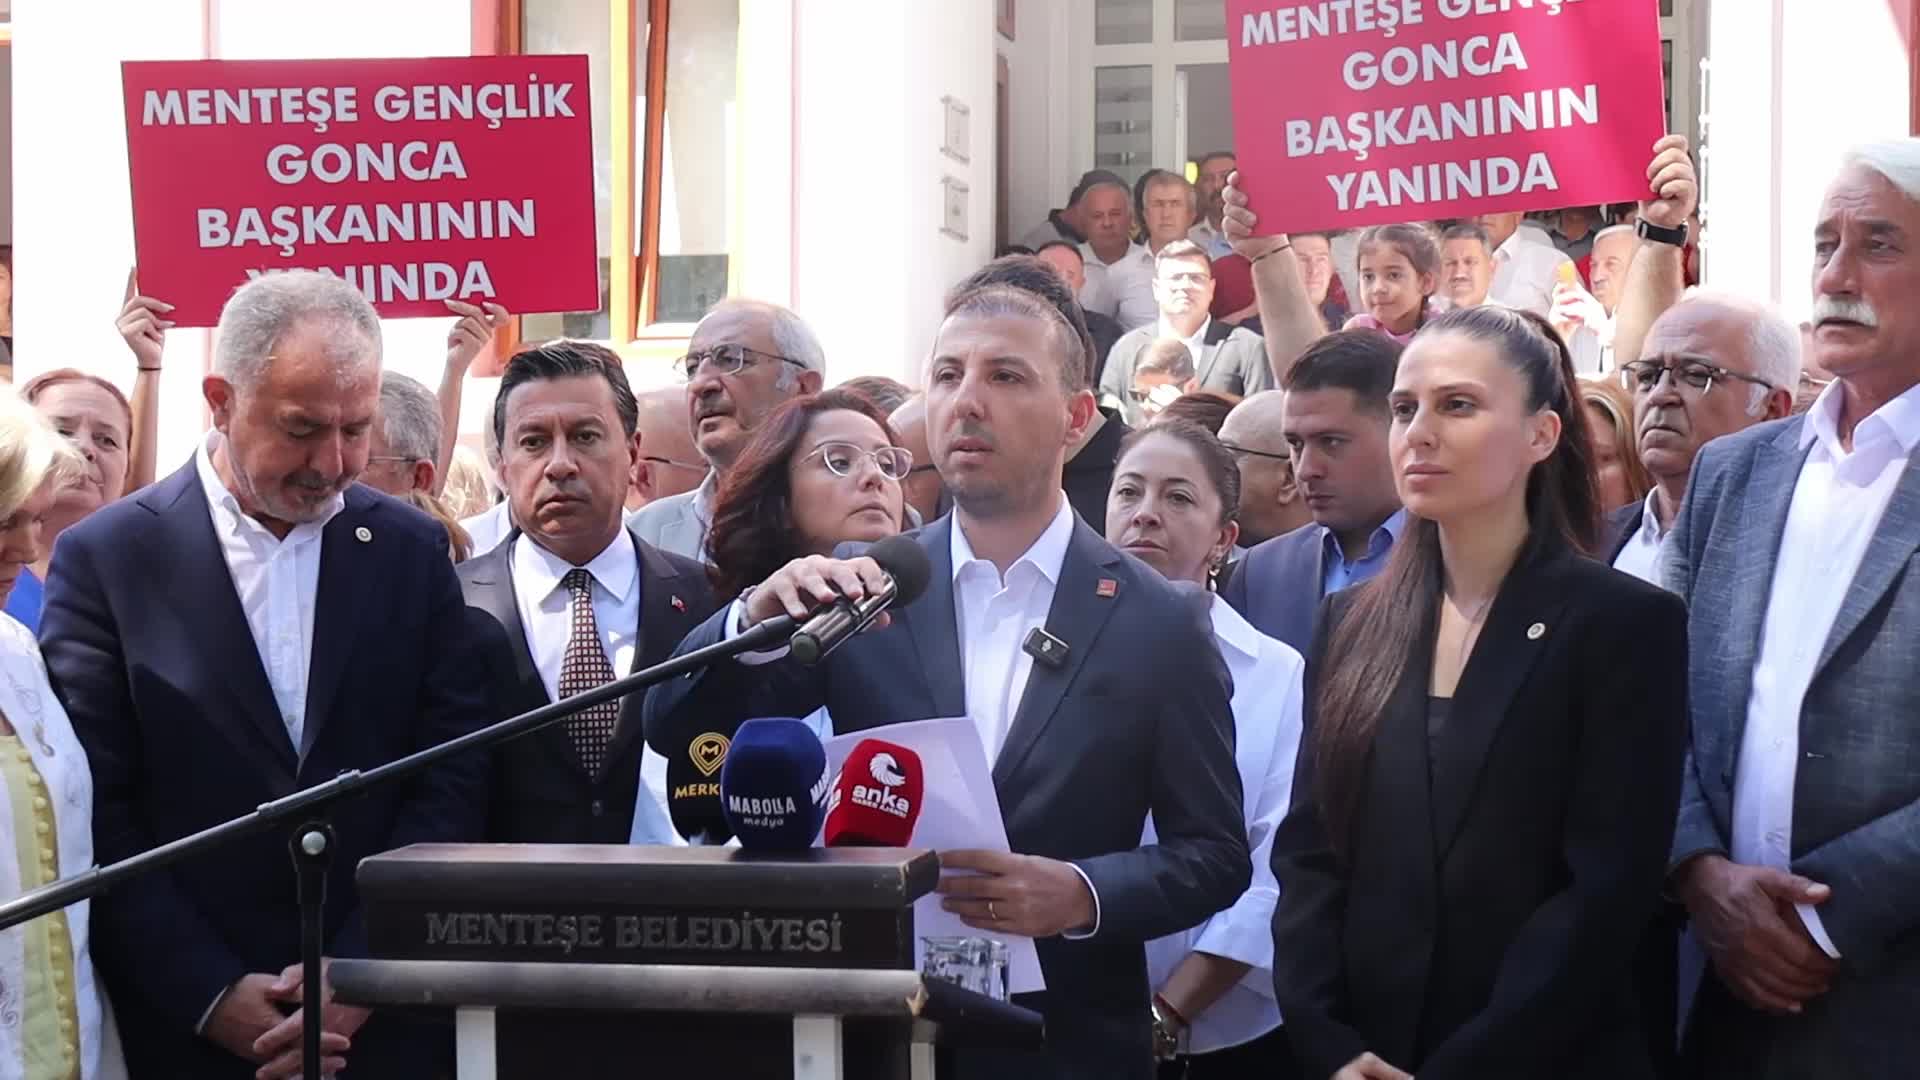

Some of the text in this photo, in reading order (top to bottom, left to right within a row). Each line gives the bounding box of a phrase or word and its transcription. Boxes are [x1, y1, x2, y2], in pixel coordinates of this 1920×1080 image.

[1241, 0, 1423, 47] MENTEŞE
[1342, 31, 1528, 91] GONCA
[142, 73, 575, 133] MENTEŞE GENÇLİK
[1285, 84, 1598, 161] BAŞKANININ
[266, 141, 467, 184] GONCA
[1326, 152, 1558, 211] YANINDA
[197, 200, 535, 257] BAŞKANININ
[743, 817, 784, 829] medya
[852, 784, 910, 814] anka
[425, 911, 842, 953] MENTEŞE BELEDİYESİ
